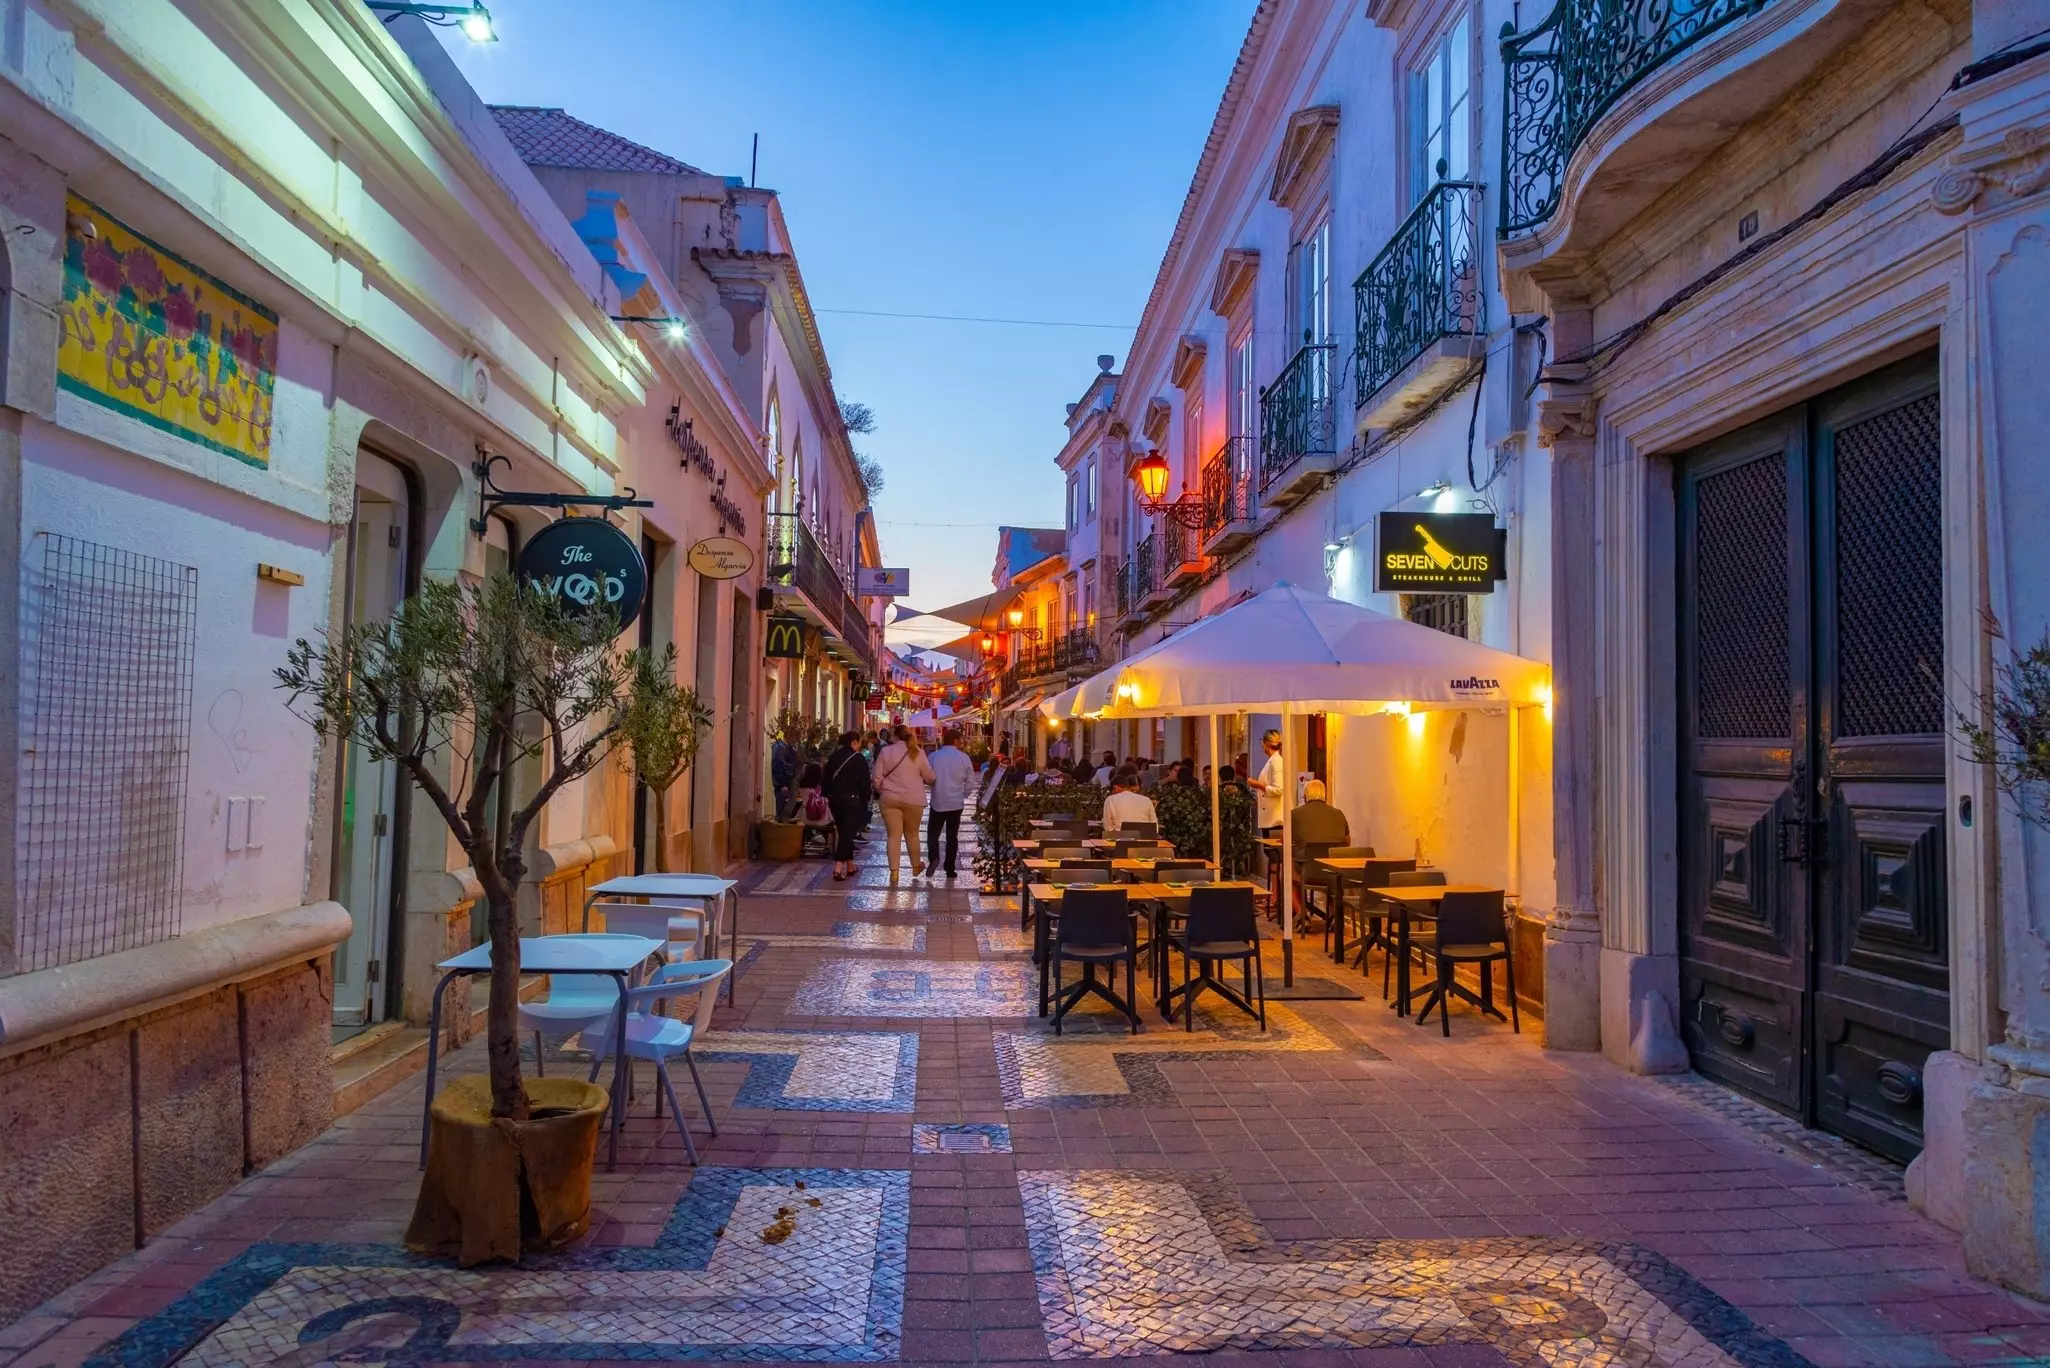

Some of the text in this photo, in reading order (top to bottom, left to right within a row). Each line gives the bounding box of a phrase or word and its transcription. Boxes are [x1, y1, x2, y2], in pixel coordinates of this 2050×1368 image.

[561, 545, 593, 565] The
[697, 543, 734, 558] Despensa
[709, 556, 747, 572] Algarvia
[1386, 554, 1488, 571] SEVEN CUTS
[1450, 676, 1500, 689] LAVAZZA
